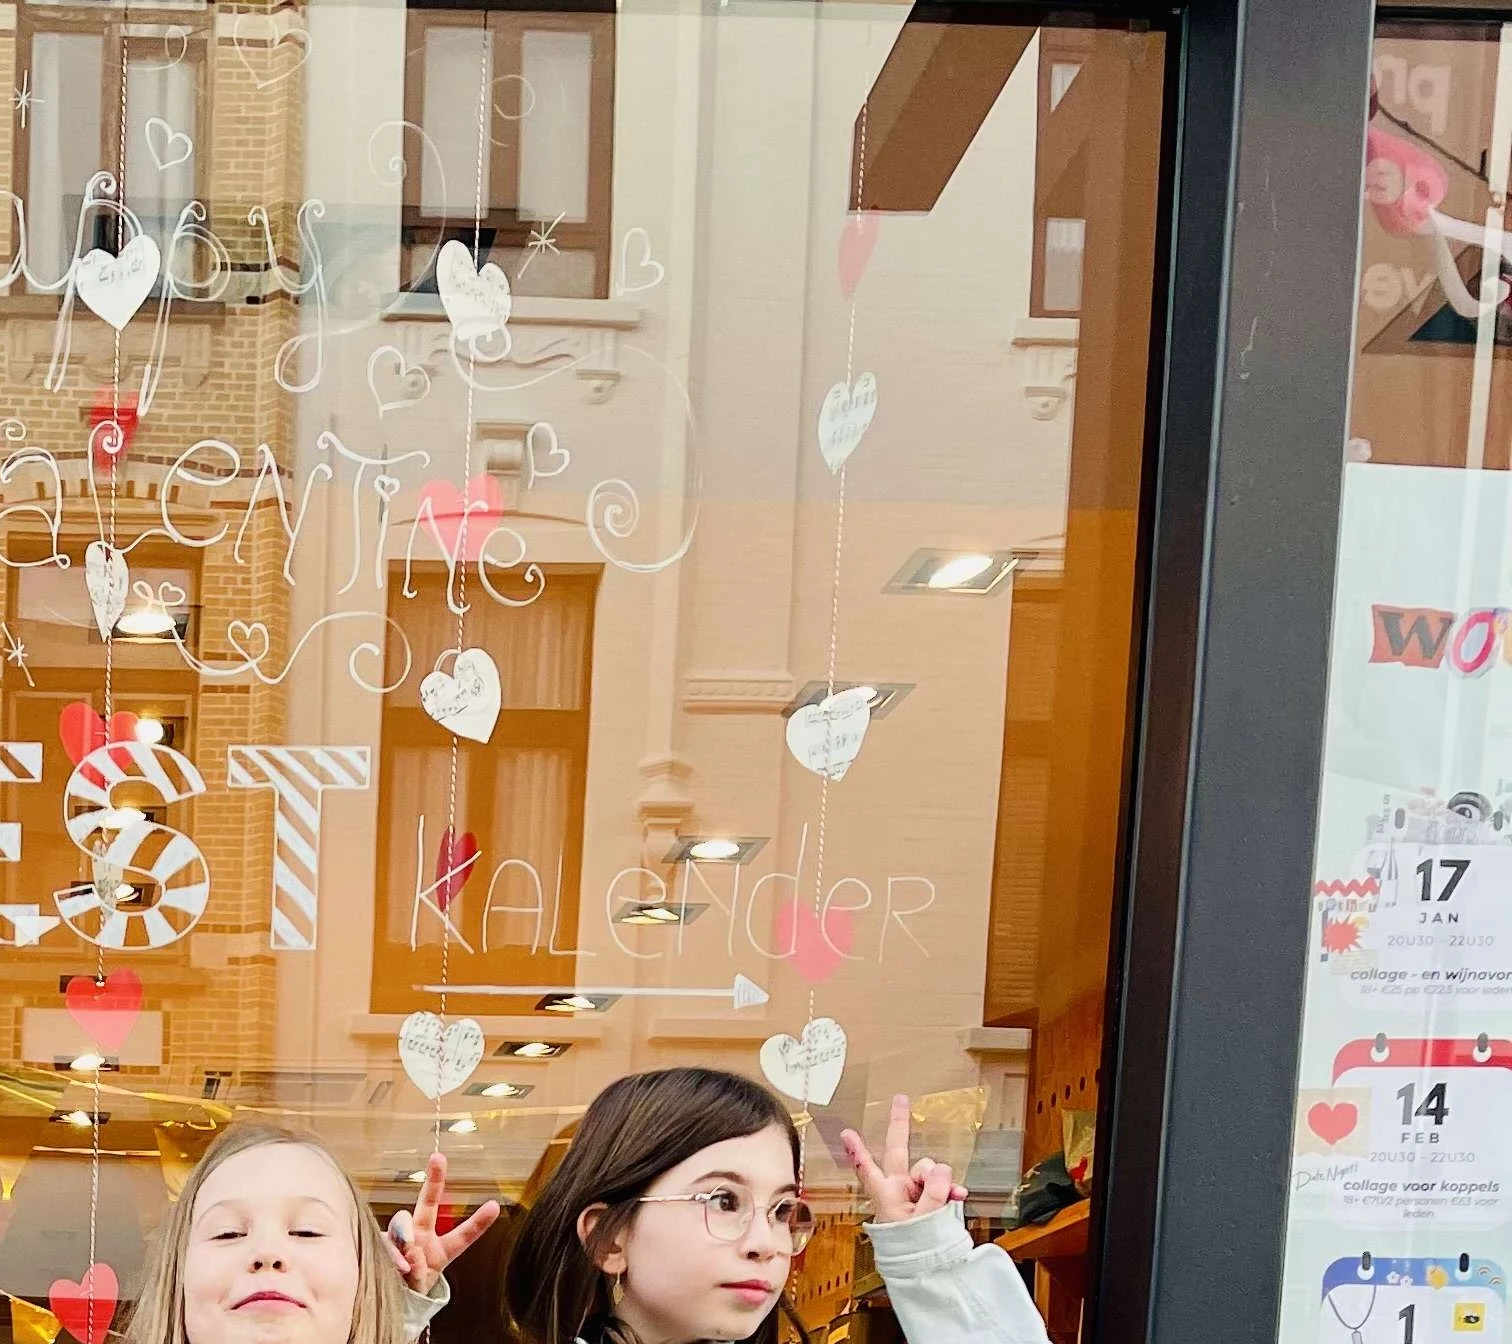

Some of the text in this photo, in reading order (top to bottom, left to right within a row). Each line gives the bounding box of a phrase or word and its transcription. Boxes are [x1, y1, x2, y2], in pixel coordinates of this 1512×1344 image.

[1378, 610, 1512, 672] WO
[1416, 858, 1472, 901] 17
[1418, 912, 1459, 924] JAN
[1350, 969, 1407, 982] collage
[1421, 972, 1440, 981] en
[1396, 1082, 1449, 1126] 14
[1401, 1132, 1440, 1143] FEB
[1343, 1179, 1500, 1195] collage voor koppels
[1398, 1304, 1416, 1344] 1
